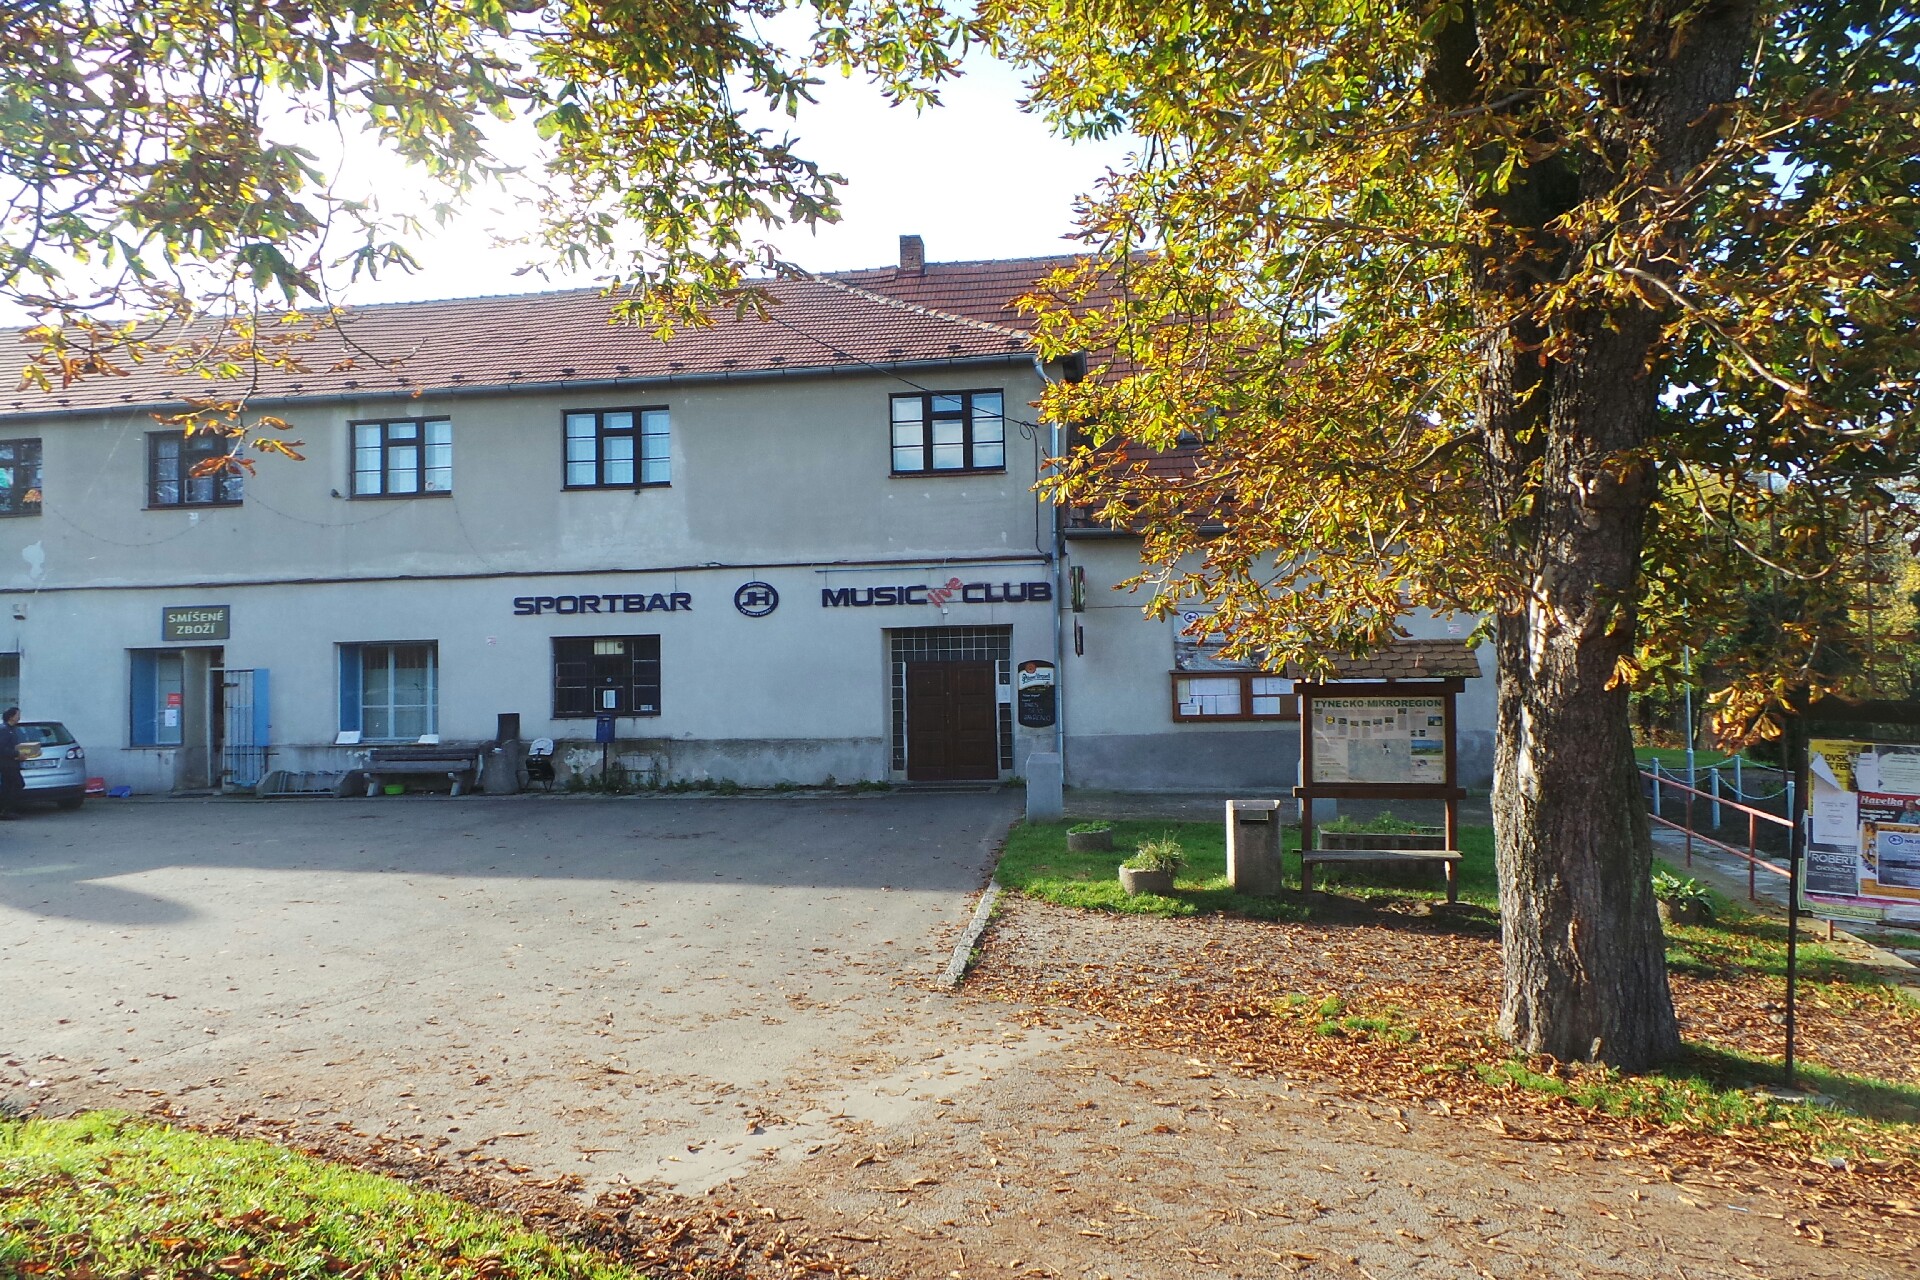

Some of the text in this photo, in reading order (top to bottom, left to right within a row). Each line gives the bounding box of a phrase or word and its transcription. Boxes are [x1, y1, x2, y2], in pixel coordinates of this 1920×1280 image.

[821, 577, 1053, 608] MUSIC live CLUB
[513, 592, 693, 615] SPORTBAR
[168, 610, 224, 623] SMÍŠENÉ
[176, 623, 216, 634] ZBOŽÍ
[1860, 796, 1904, 807] Havelka
